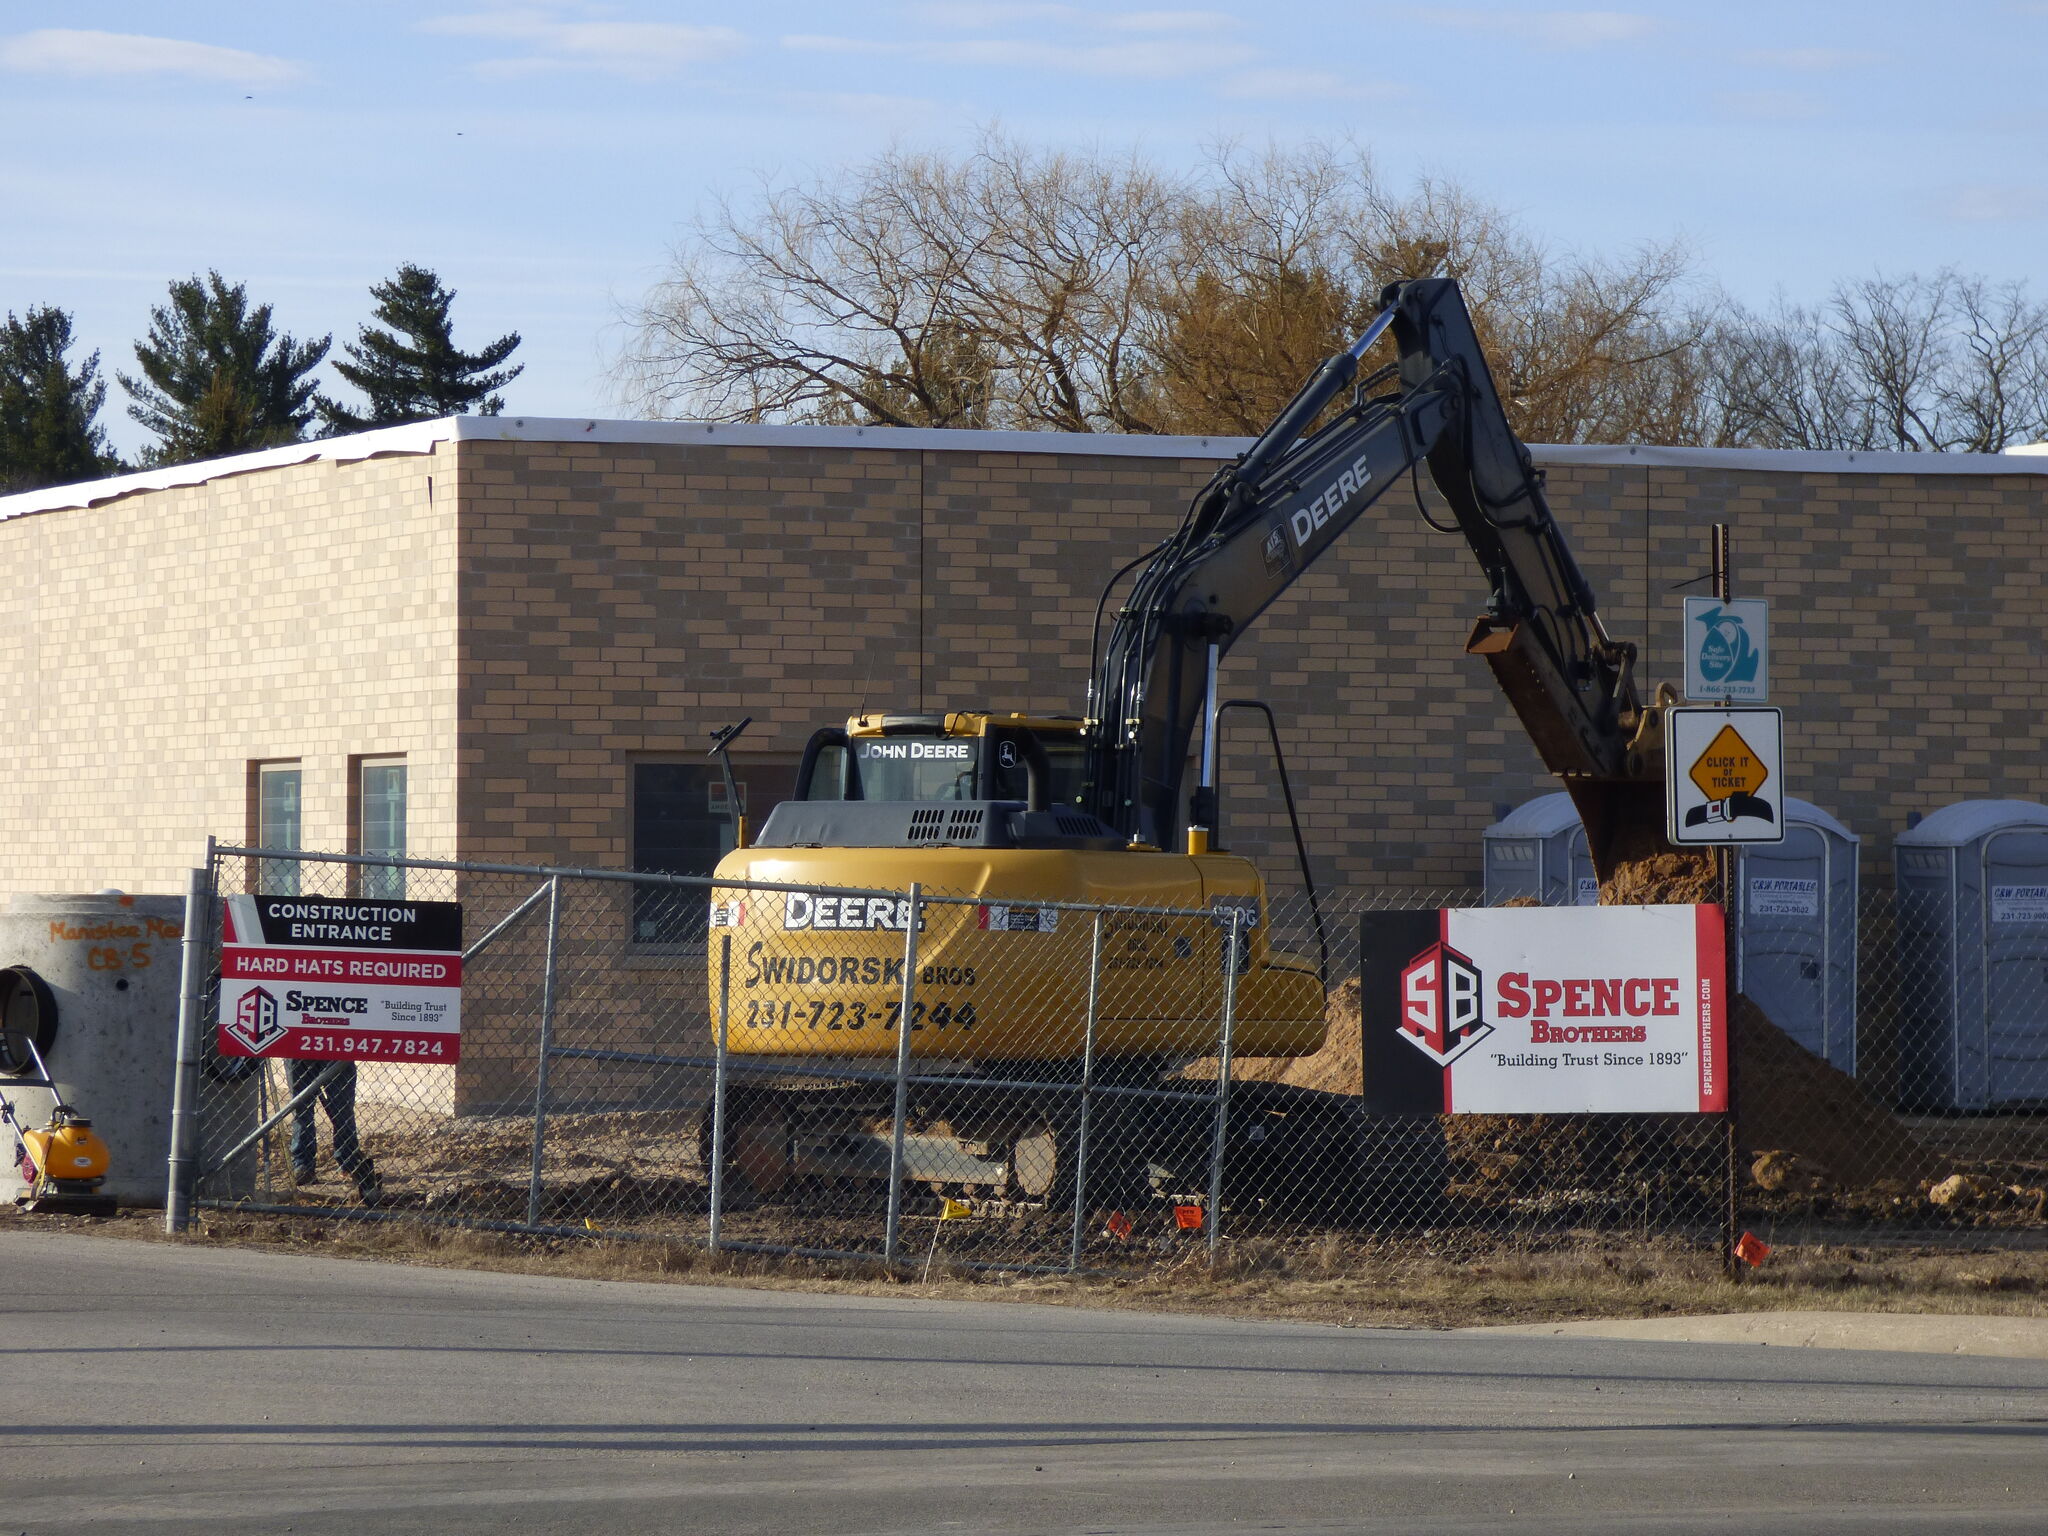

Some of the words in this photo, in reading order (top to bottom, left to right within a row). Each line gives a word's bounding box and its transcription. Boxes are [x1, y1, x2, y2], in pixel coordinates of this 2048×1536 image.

[1291, 454, 1372, 547] DEERE
[1701, 652, 1732, 662] Delivery
[860, 743, 906, 759] JOHN
[911, 742, 969, 759] DEERE
[1706, 756, 1735, 767] CLICK
[1740, 756, 1749, 767] IT
[1711, 777, 1747, 788] TICKET
[268, 903, 416, 923] CONSTRUCTION
[784, 892, 925, 931] DEERE
[291, 923, 392, 941] ENTRANCE
[236, 956, 289, 973] HARD
[294, 959, 344, 976] HATS
[350, 961, 447, 980] REQUIRED
[746, 941, 916, 988] SWIDORSK
[922, 966, 976, 986] BROS
[285, 990, 368, 1014] SPENCE
[1497, 972, 1680, 1018] SPENCE
[424, 1001, 448, 1012] Trust
[746, 1000, 977, 1031] 231-723-7244
[301, 1013, 350, 1026] BROTHERS
[391, 1012, 416, 1022] Since
[1530, 1020, 1647, 1043] BROTHERS
[1703, 978, 1712, 1096] SPENCEBROTHERS.COM
[300, 1035, 444, 1056] 231.947.7824
[1562, 1053, 1600, 1066] Trust
[1603, 1053, 1644, 1066] Since
